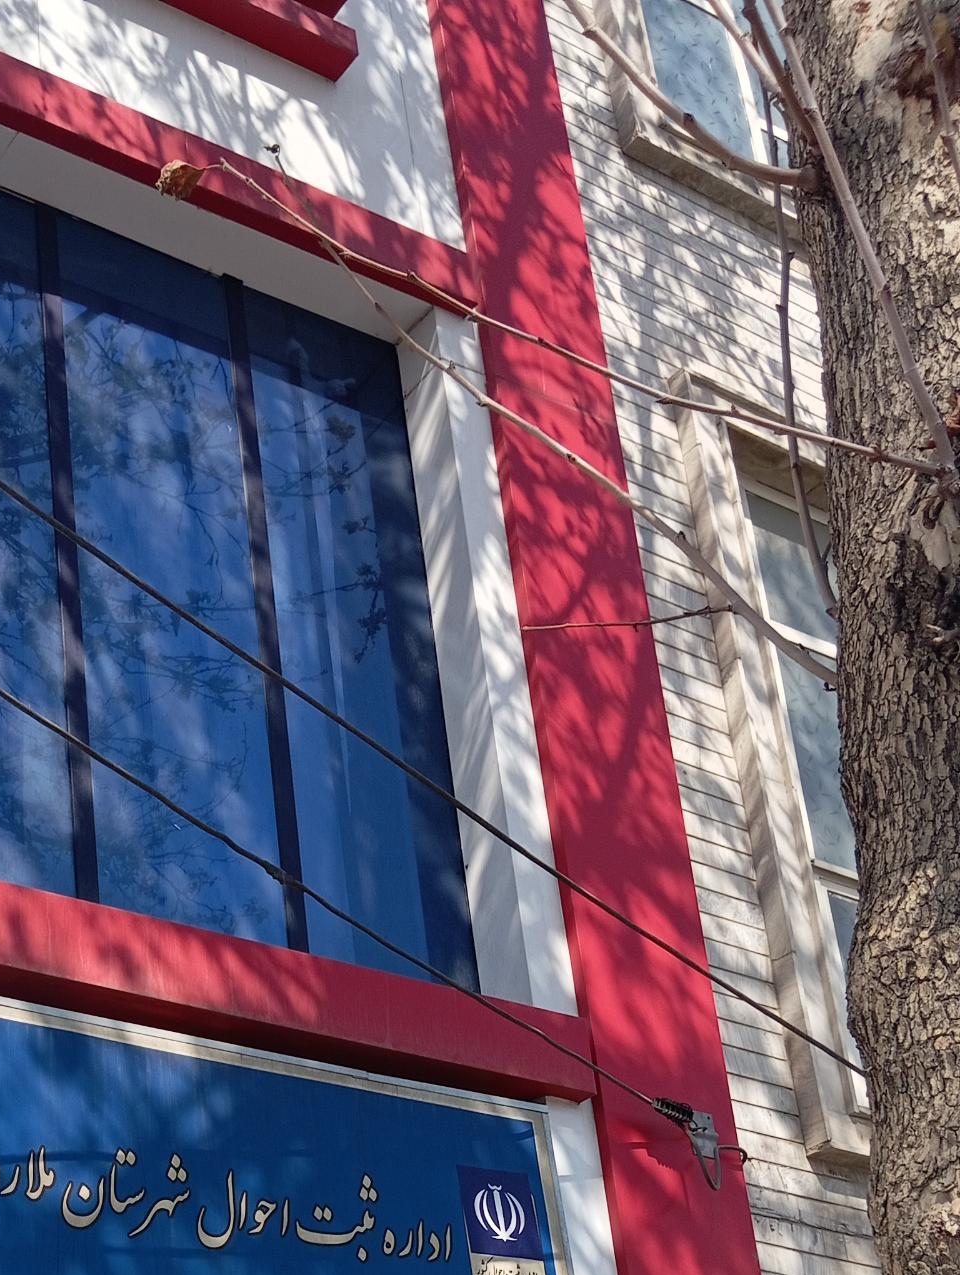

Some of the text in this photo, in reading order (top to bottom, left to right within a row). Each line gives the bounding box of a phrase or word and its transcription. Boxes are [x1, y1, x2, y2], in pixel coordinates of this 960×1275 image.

[61, 1148, 191, 1237] شهرستان
[196, 1168, 289, 1249] احوال
[295, 1174, 378, 1262] ثبت
[383, 1220, 451, 1262] اداره
[477, 1256, 493, 1275] کشور
